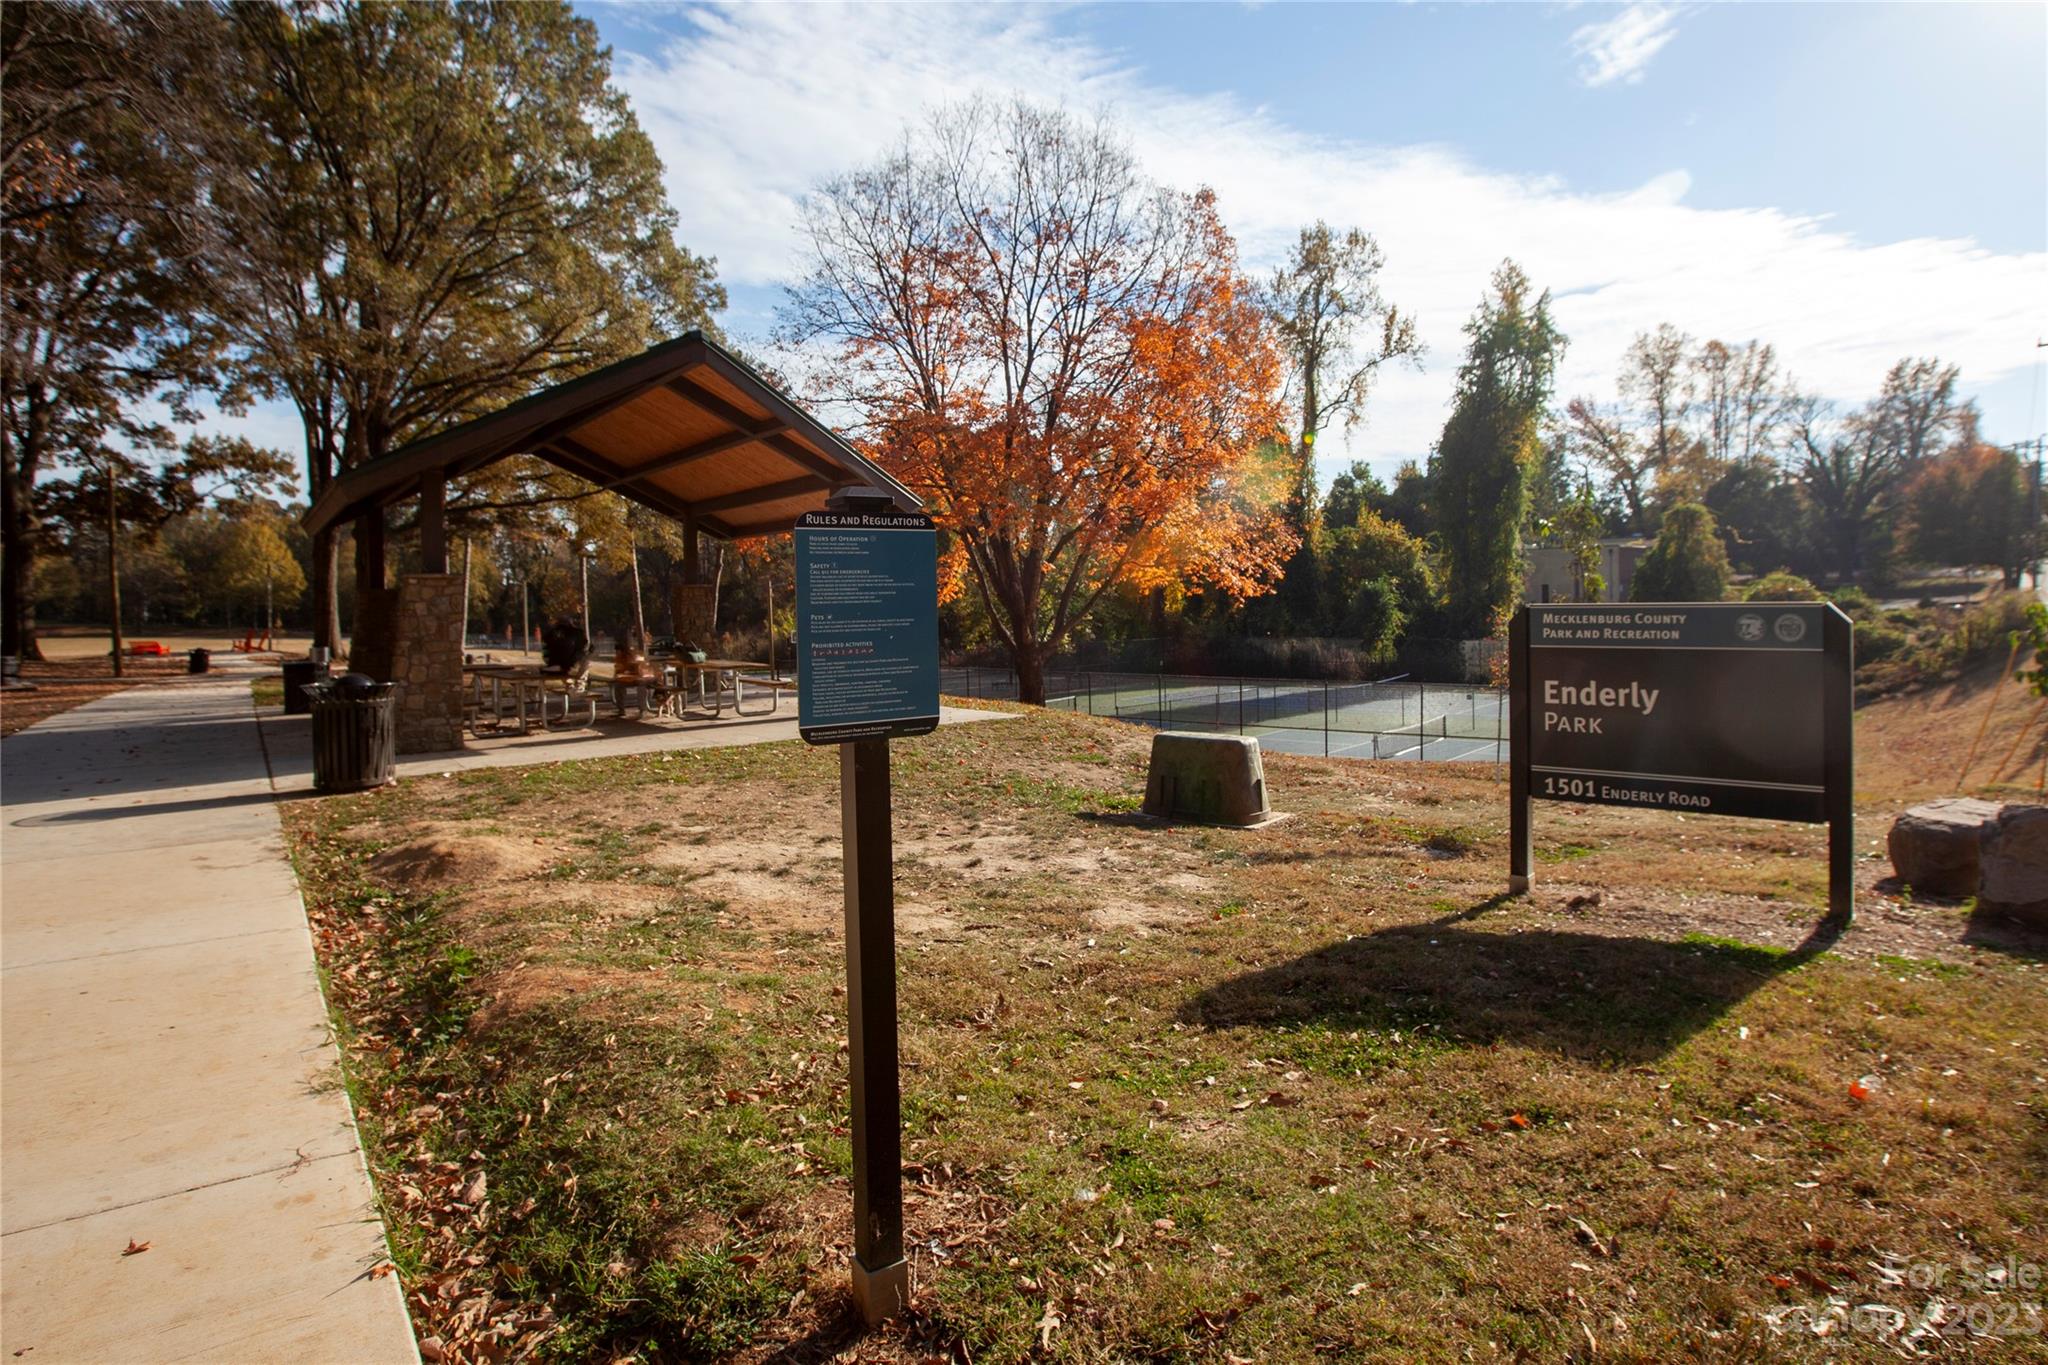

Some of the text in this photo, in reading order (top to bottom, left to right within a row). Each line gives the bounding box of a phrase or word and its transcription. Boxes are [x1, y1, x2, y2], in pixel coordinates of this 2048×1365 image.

[806, 513, 926, 527] RULES AND REGULATIONS
[1542, 613, 1686, 625] MECKLENBURG COUNTY
[1542, 628, 1680, 640] PARK AND RECREATION
[1543, 680, 1660, 715] Enderly
[1544, 711, 1603, 734] PARK
[1544, 776, 1711, 808] 1501 ENDERLY ROAD
